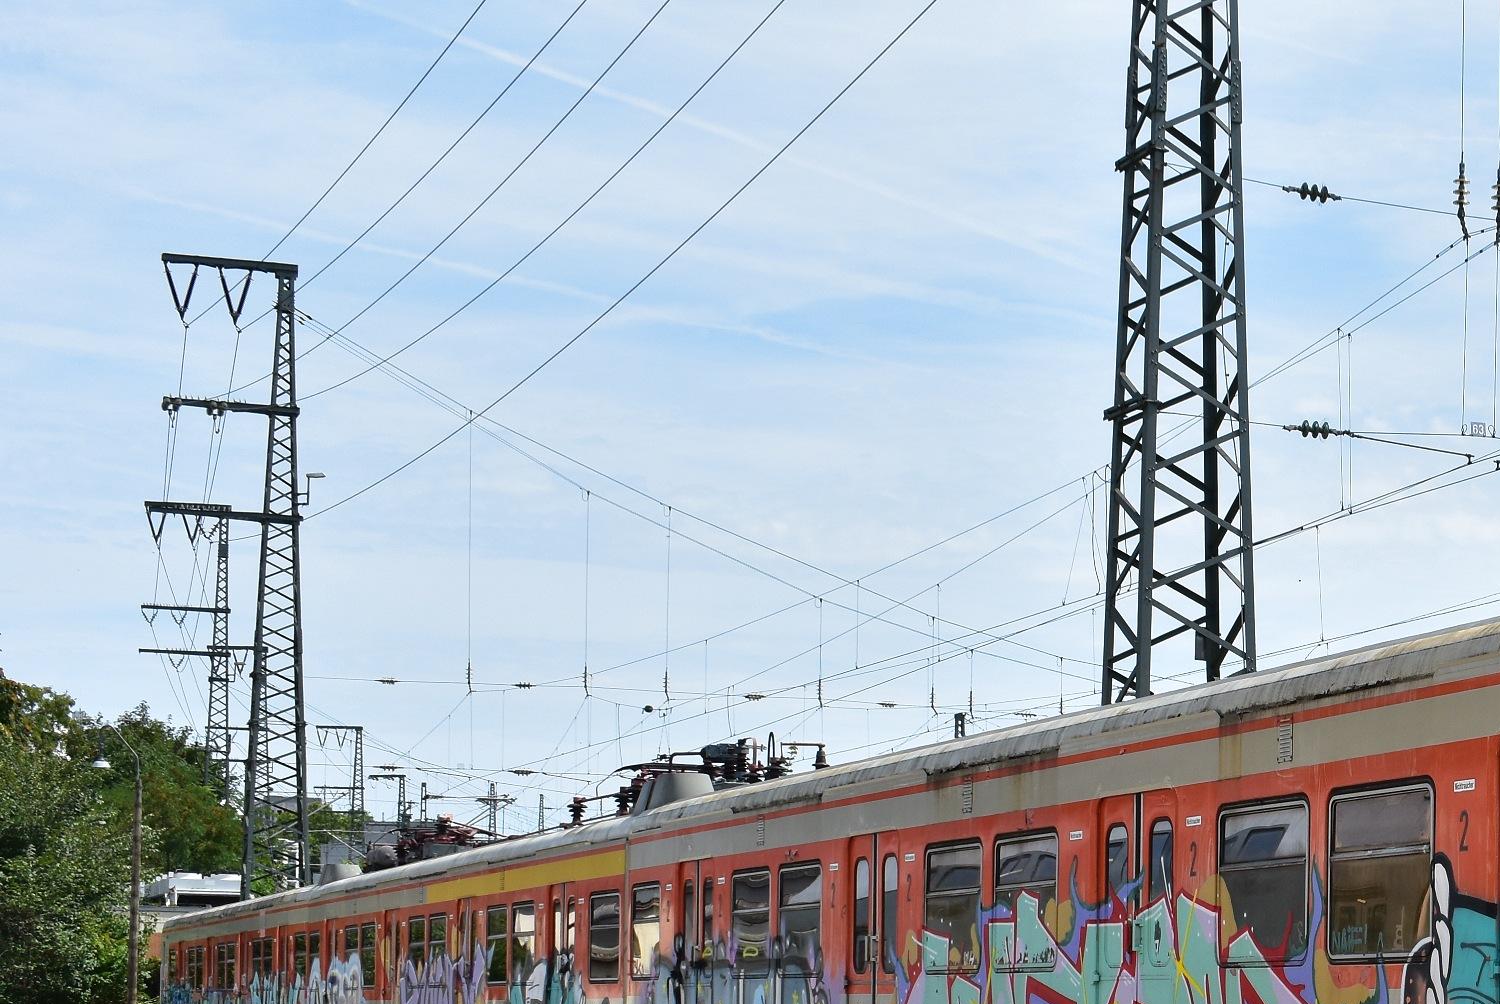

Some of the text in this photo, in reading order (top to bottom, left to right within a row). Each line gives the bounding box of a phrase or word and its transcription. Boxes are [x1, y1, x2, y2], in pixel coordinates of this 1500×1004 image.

[1472, 423, 1485, 435] 63
[1459, 809, 1468, 852] 2
[1190, 841, 1197, 877] 2
